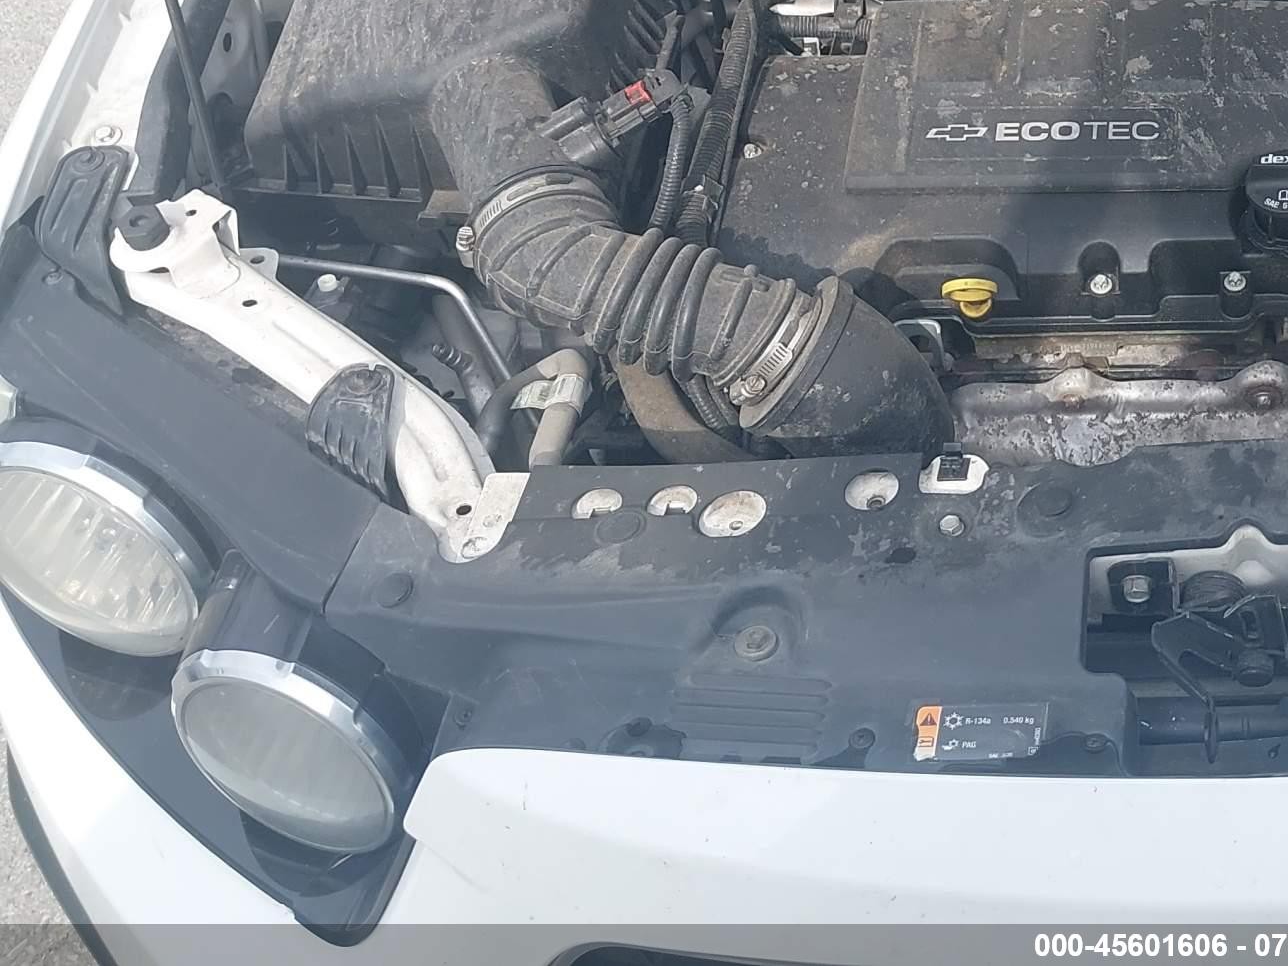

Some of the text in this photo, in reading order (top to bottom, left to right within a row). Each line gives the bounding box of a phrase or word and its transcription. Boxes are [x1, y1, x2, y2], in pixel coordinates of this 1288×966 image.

[995, 121, 1160, 141] ECOTEC
[1264, 198, 1279, 208] SAE
[1025, 717, 1034, 725] kg
